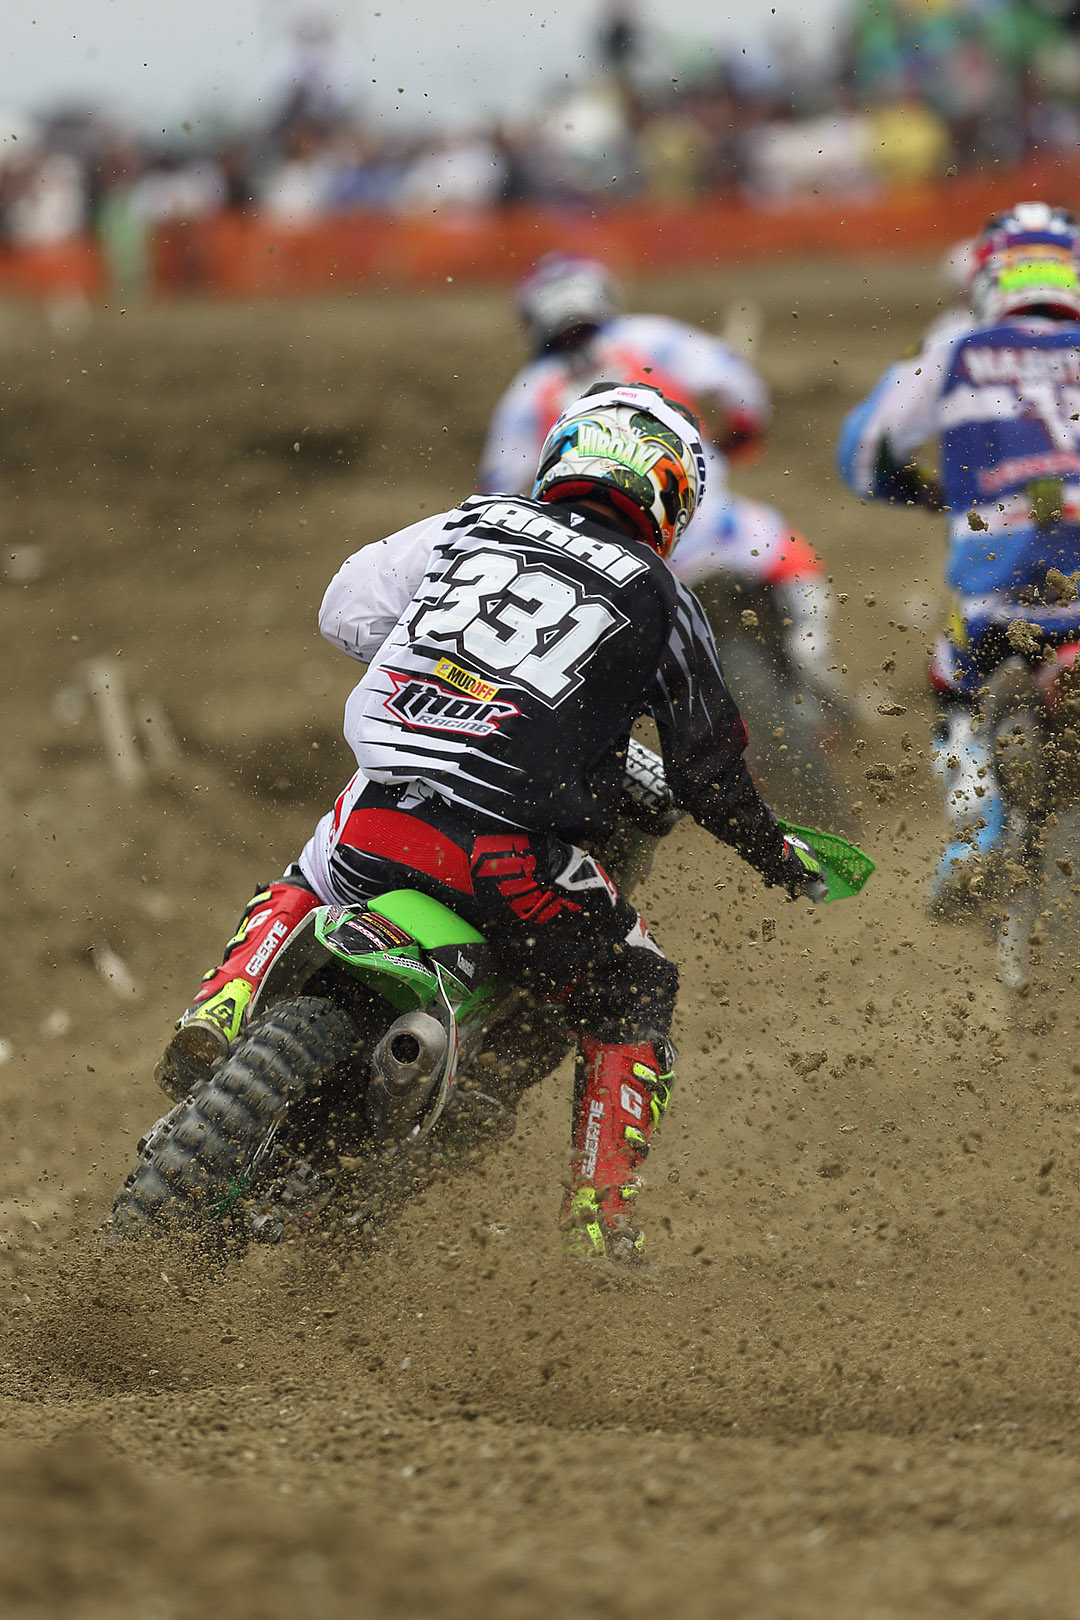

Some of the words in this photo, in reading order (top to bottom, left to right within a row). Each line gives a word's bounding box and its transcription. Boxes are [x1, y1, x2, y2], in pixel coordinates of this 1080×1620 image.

[578, 423, 666, 477] HIROAKI
[477, 501, 649, 586] ARAI
[409, 549, 629, 707] 331
